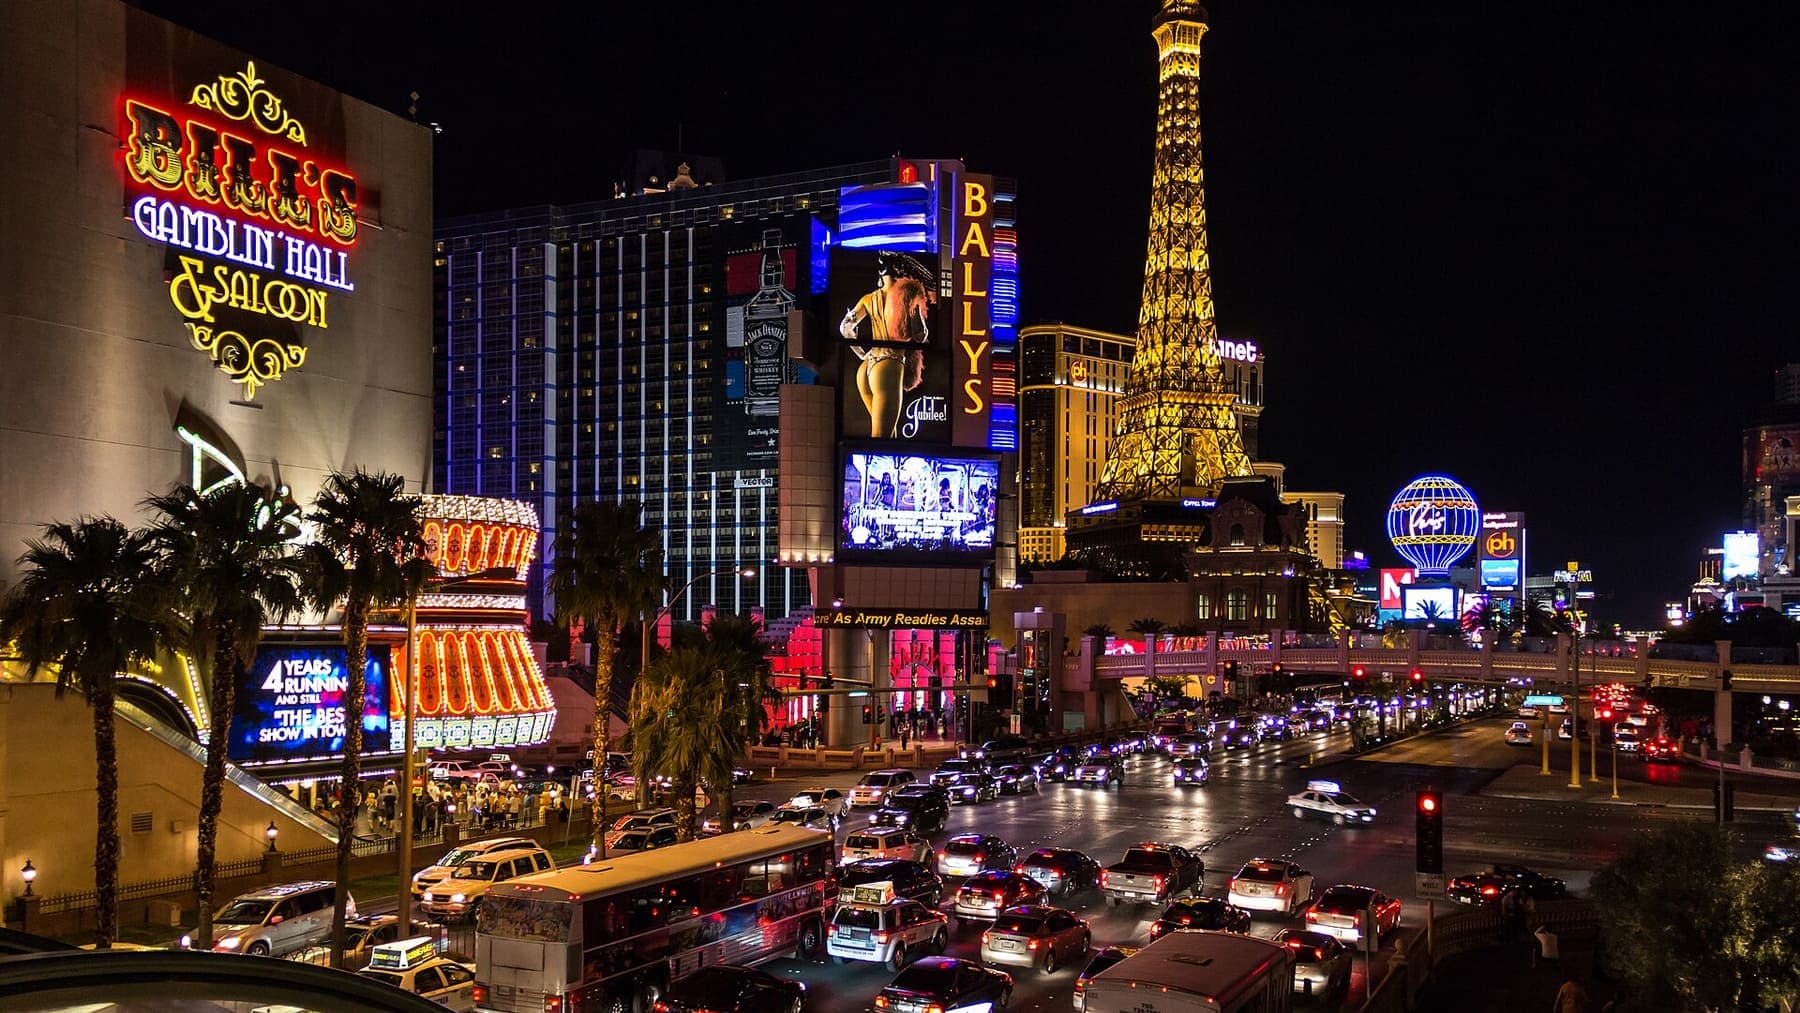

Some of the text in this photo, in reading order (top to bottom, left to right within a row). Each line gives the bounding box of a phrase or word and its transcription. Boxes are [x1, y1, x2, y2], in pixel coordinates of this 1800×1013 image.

[125, 98, 359, 245] BILL'S
[134, 197, 354, 290] GAMBLIN' HALL
[170, 256, 328, 328] & SALOON
[960, 182, 990, 414] BALLYS
[902, 396, 947, 438] Jubilee!
[1489, 532, 1515, 554] ph
[834, 612, 851, 624] As
[855, 612, 892, 627] Army
[894, 613, 947, 625] Readies
[261, 659, 332, 693] 4 YEARS
[285, 677, 348, 693] RUNNIN
[275, 694, 321, 705] AND STILL
[316, 707, 346, 725] BES
[259, 726, 347, 742] SHOW IN TOW
